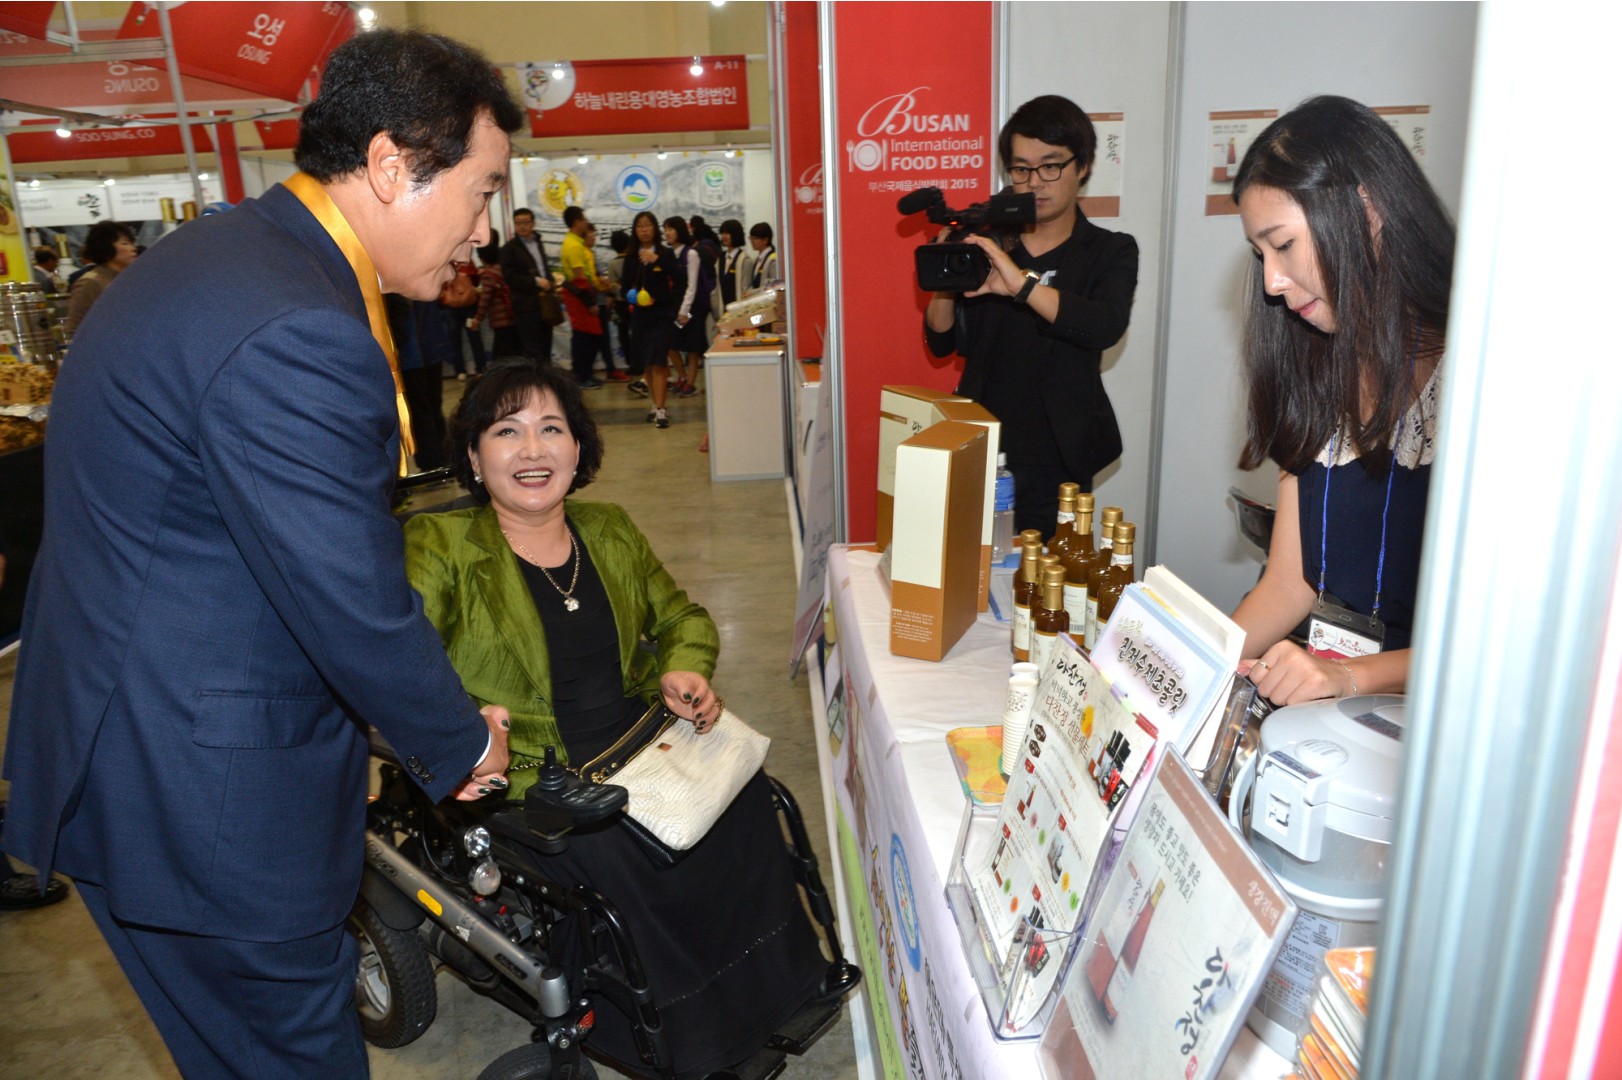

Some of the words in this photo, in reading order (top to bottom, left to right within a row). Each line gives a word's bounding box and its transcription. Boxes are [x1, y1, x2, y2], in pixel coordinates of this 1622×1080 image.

[246, 13, 286, 46] 오성
[237, 43, 272, 64] OSUNG
[714, 61, 739, 70] A-11
[573, 86, 737, 111] 하늘내린용대영농조합법인
[856, 86, 970, 137] BUSAN
[75, 132, 101, 142] SOO
[891, 136, 984, 152] International
[891, 156, 937, 171] FOOD
[940, 154, 983, 170] EXPO
[950, 179, 977, 190] 2015
[1165, 825, 1179, 848] 좋고
[1176, 843, 1189, 867] 맛도
[1186, 861, 1201, 887] 좋은
[1158, 842, 1176, 872] 드시고
[1173, 864, 1194, 904] 가세요!
